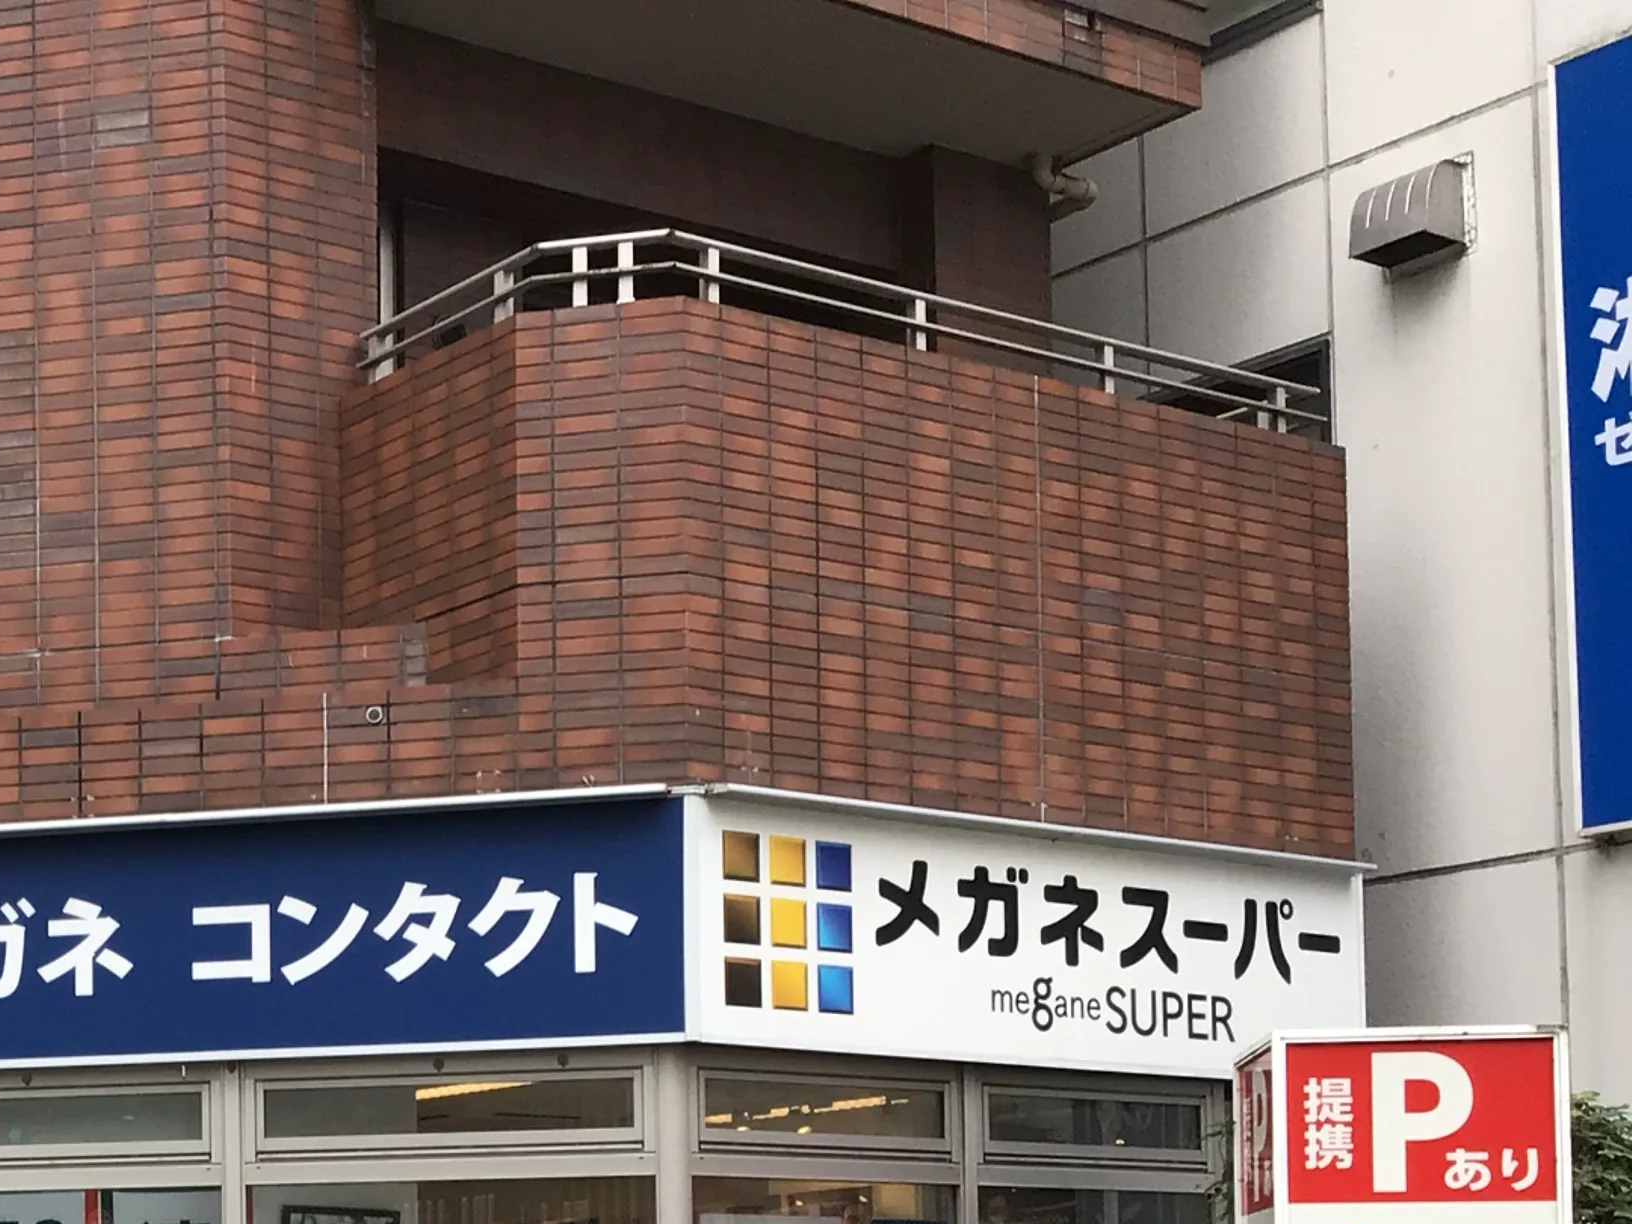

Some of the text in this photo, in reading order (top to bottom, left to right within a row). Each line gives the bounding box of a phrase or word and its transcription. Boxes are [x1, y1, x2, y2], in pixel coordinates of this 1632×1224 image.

[191, 872, 639, 986] コンタクト
[875, 859, 1342, 984] メガネスーパー
[1302, 1077, 1355, 1170] 提携
[1371, 1051, 1474, 1193] P
[1444, 1148, 1540, 1191] あり
